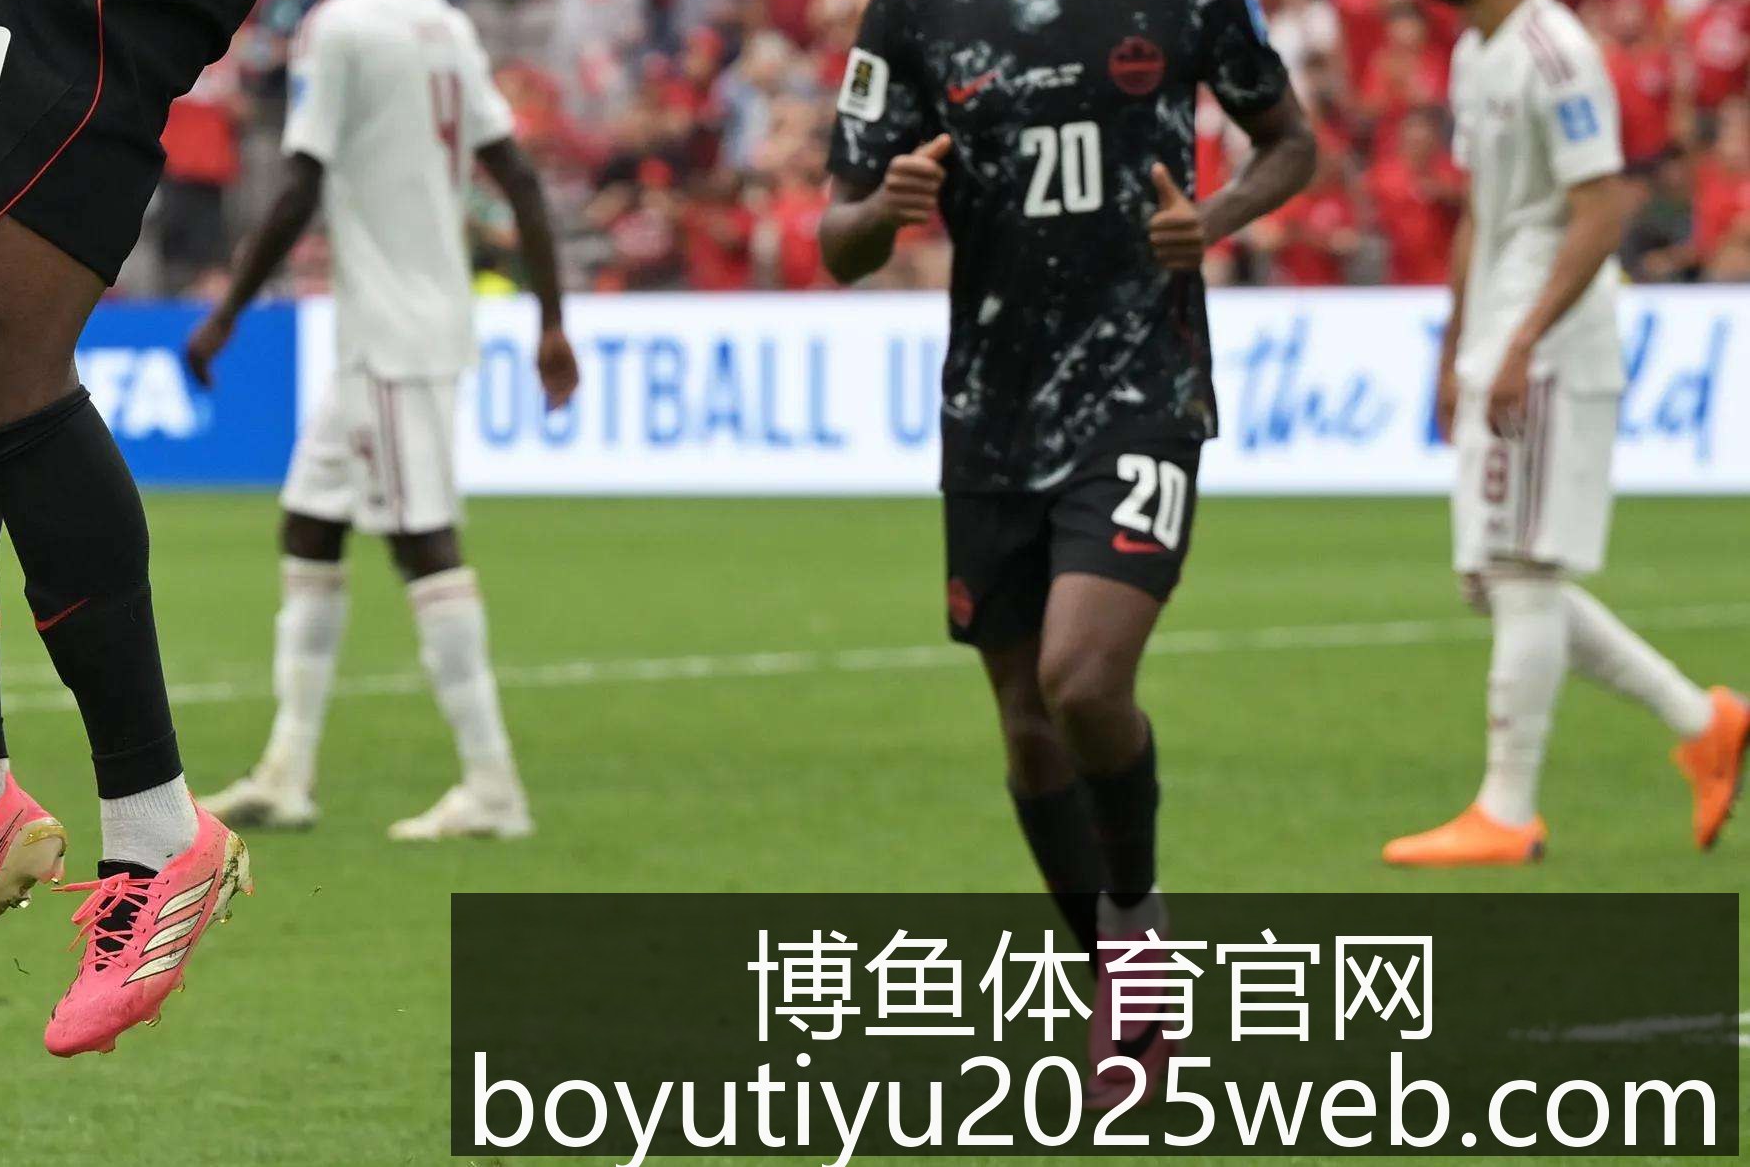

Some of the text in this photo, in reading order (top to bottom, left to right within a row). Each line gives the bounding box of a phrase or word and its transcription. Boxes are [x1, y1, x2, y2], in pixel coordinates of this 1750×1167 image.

[1019, 120, 1104, 217] 20
[76, 348, 198, 439] FA
[478, 337, 844, 449] OTBALL
[1230, 315, 1392, 450] the
[1111, 453, 1188, 551] 20
